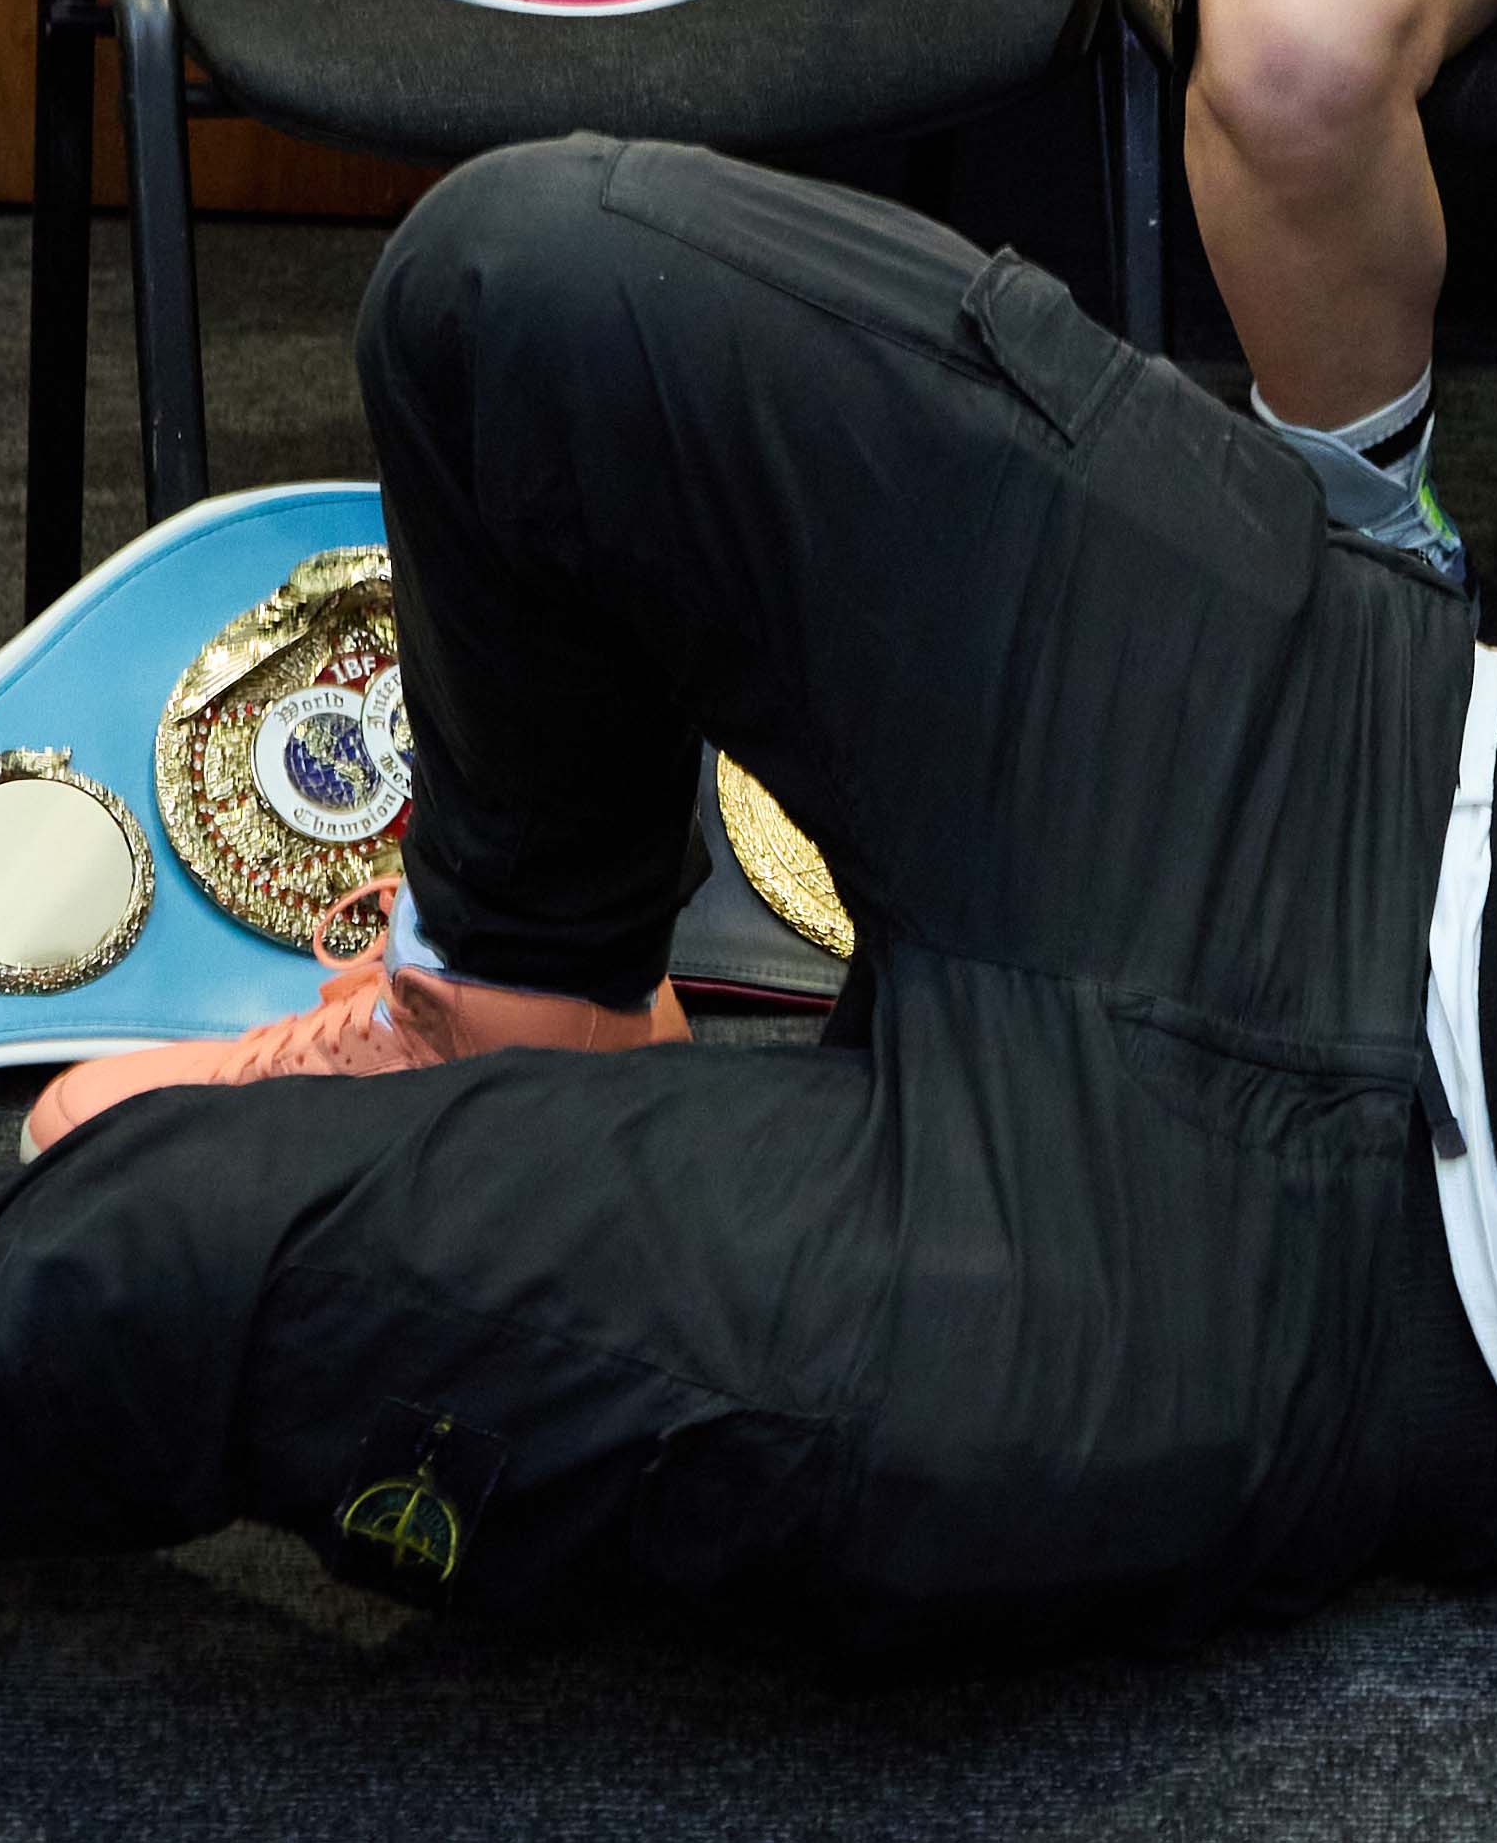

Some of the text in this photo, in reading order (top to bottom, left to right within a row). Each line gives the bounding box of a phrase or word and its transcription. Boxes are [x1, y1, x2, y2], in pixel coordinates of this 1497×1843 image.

[329, 656, 377, 685] IBF
[273, 690, 344, 727] World
[293, 791, 397, 837] Champion
